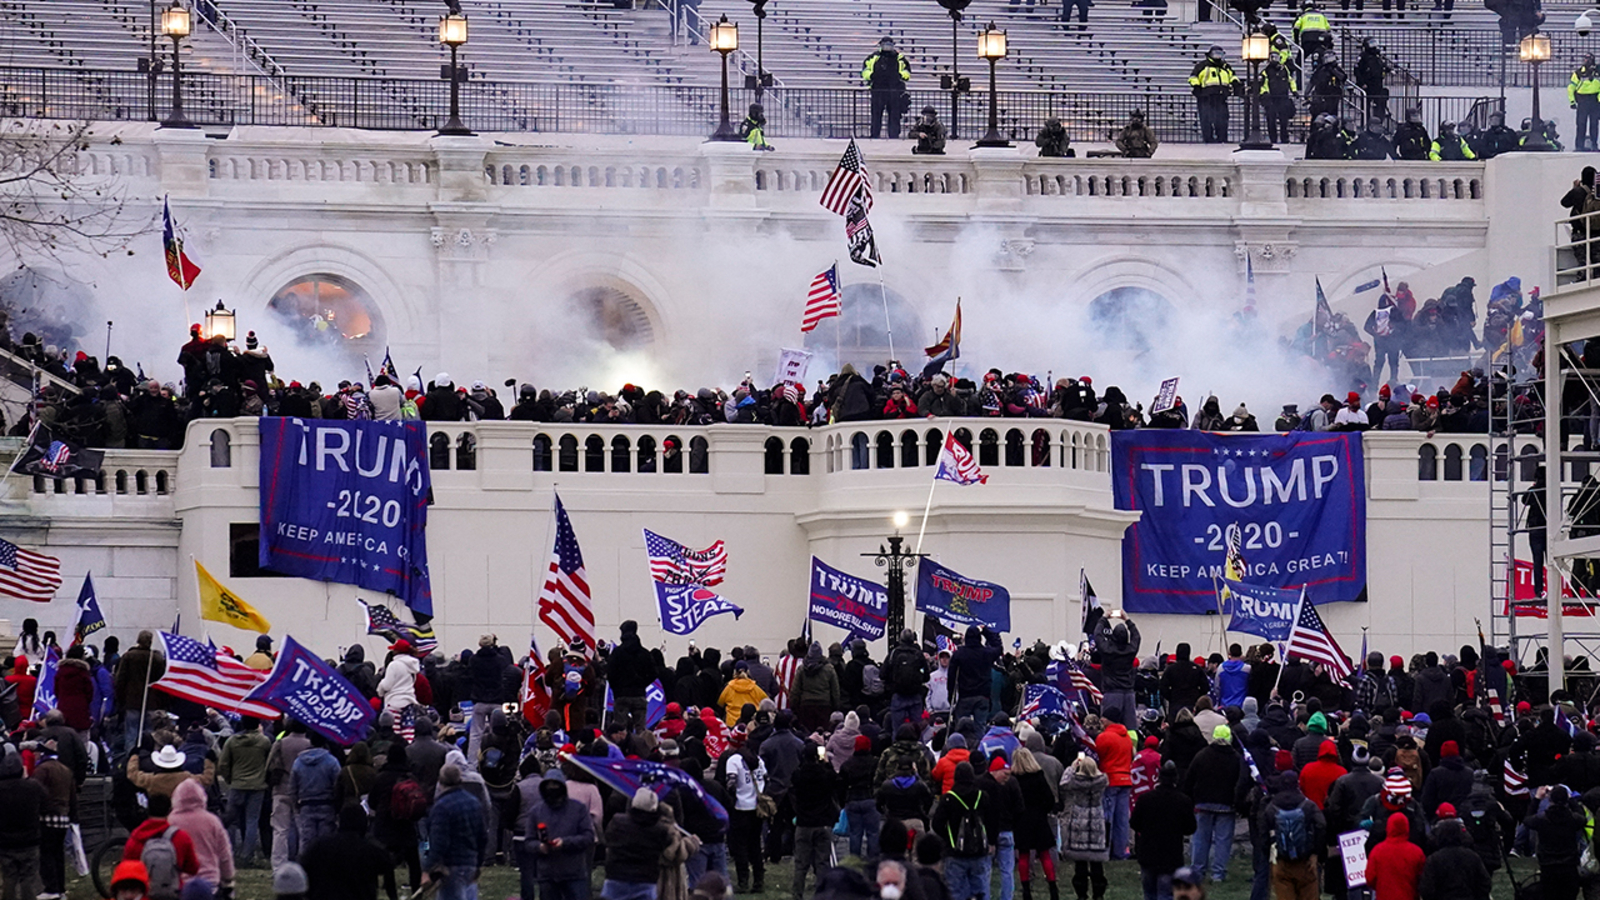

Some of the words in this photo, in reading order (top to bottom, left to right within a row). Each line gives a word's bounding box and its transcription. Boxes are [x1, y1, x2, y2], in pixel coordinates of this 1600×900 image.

[1141, 455, 1339, 509] TRUMP
[277, 522, 319, 541] KEEP
[324, 531, 389, 555] AMECA
[1147, 563, 1191, 579] KEEP
[1197, 564, 1280, 579] AMICA
[1287, 550, 1348, 574] GREAT!
[815, 565, 889, 610] TRUMP
[931, 573, 994, 603] TRUMP
[671, 600, 733, 633] STEAL
[851, 614, 883, 637] BLSHIT
[292, 658, 364, 724] TRUMP
